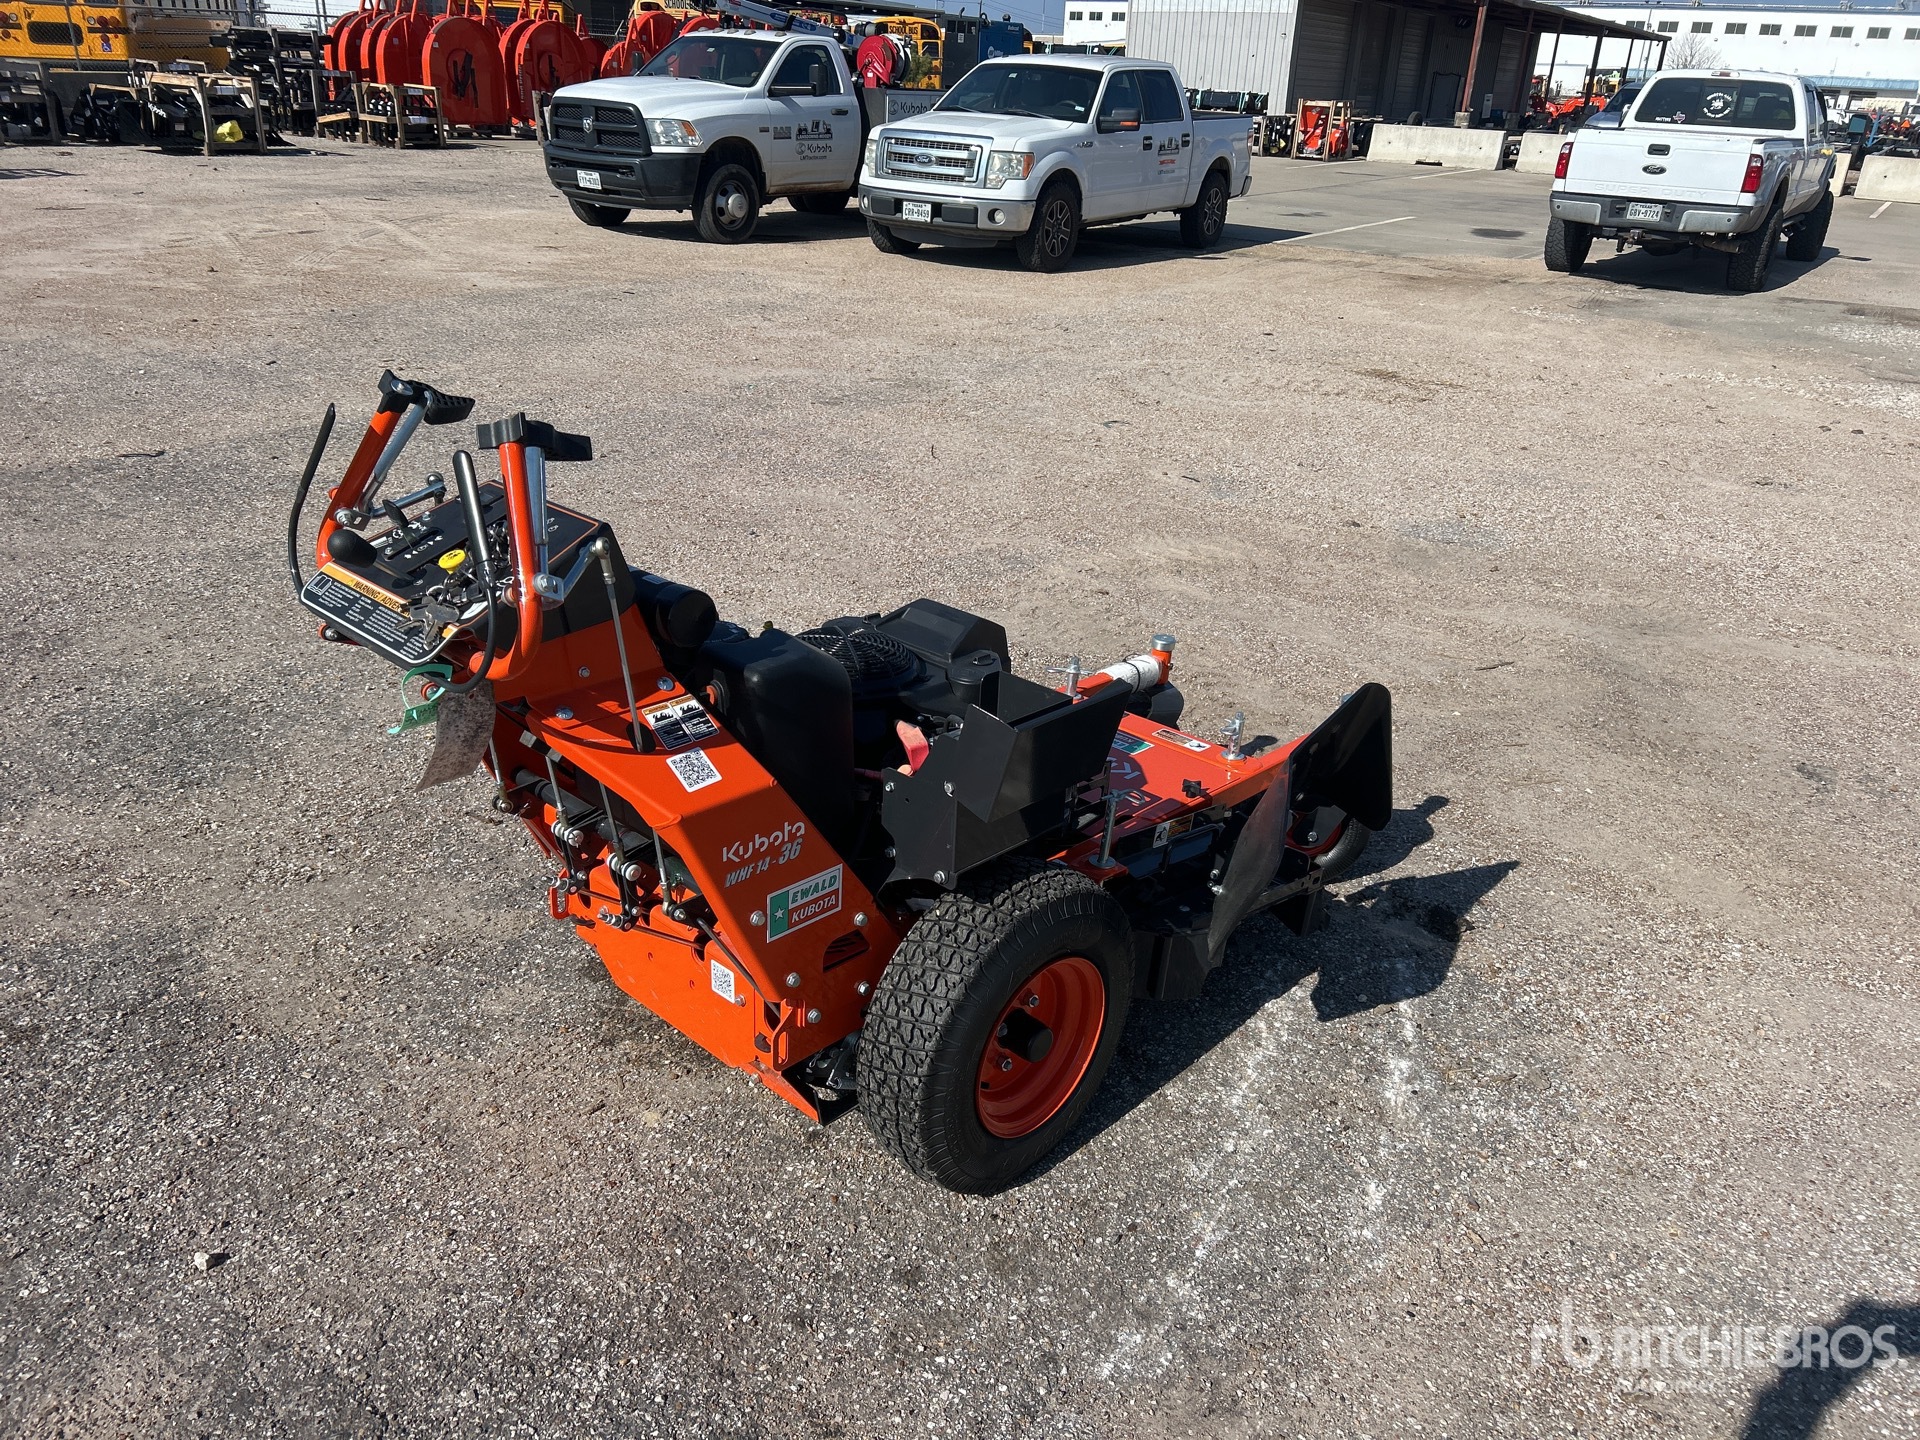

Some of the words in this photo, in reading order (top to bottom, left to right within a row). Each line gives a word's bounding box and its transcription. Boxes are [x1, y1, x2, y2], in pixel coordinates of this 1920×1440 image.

[889, 25, 907, 35] SCHOOL
[909, 26, 918, 35] BUS
[900, 101, 928, 114] Kubota
[807, 143, 832, 154] Kubota
[1594, 183, 1649, 196] SUPER
[1662, 187, 1707, 199] DUTY
[353, 580, 381, 600] WARNING
[722, 821, 805, 863] Kubota
[725, 863, 755, 889] WHF
[790, 874, 838, 905] EWALD
[791, 894, 836, 924] KUBOTA
